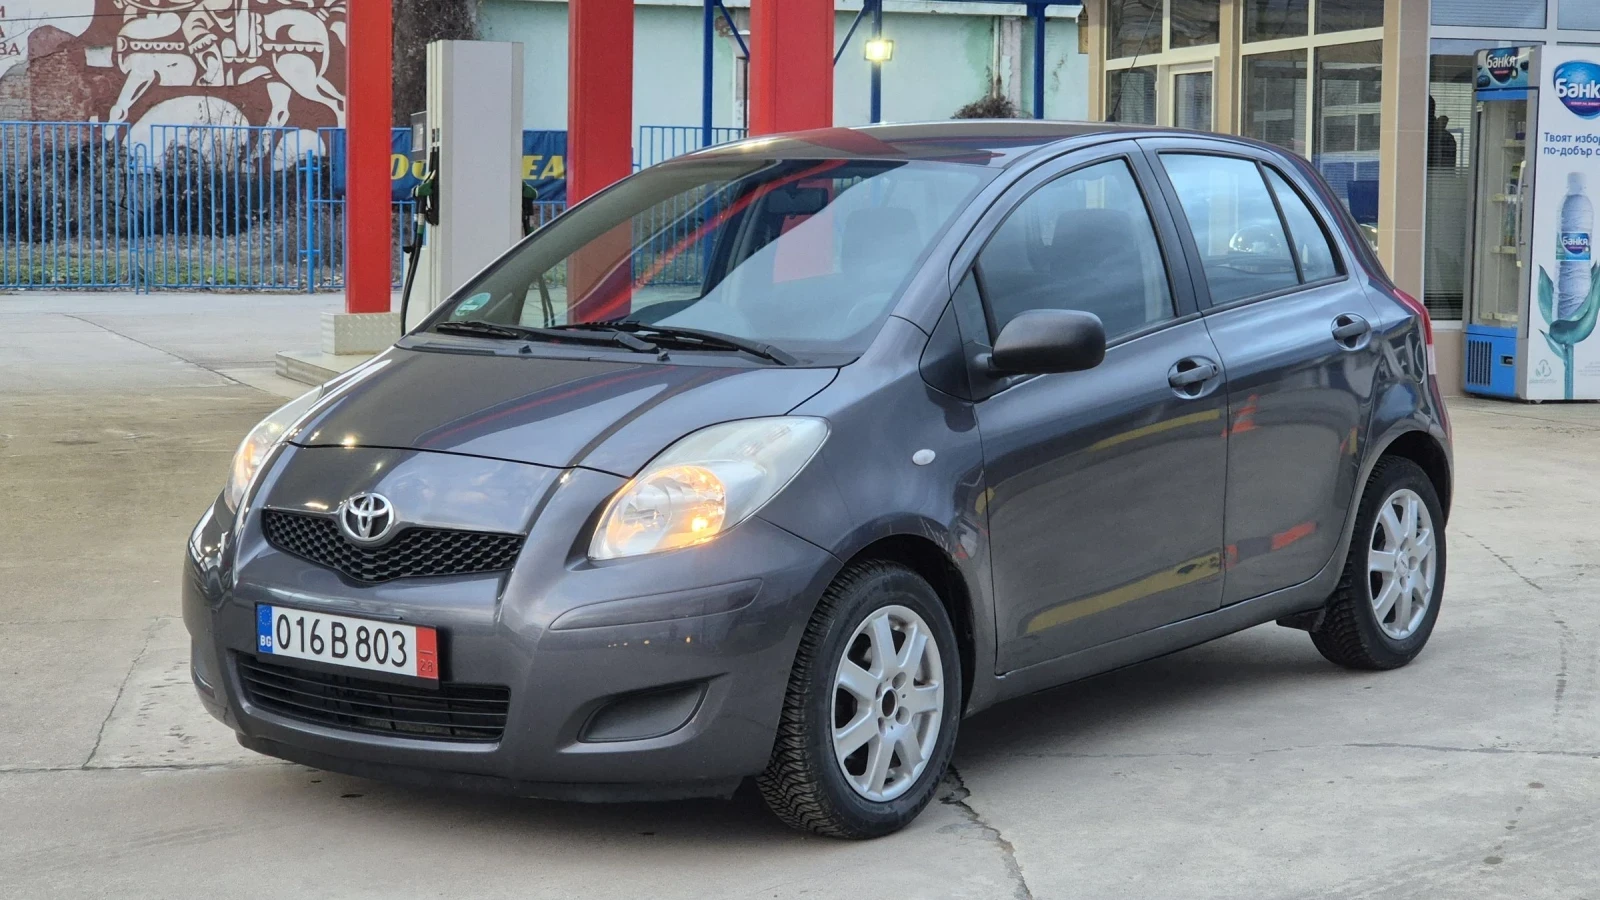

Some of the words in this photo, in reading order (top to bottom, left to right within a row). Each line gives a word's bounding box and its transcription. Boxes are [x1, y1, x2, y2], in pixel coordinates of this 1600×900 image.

[1543, 132, 1572, 143] Твоят
[1543, 145, 1592, 158] по-добър
[260, 634, 272, 647] BG
